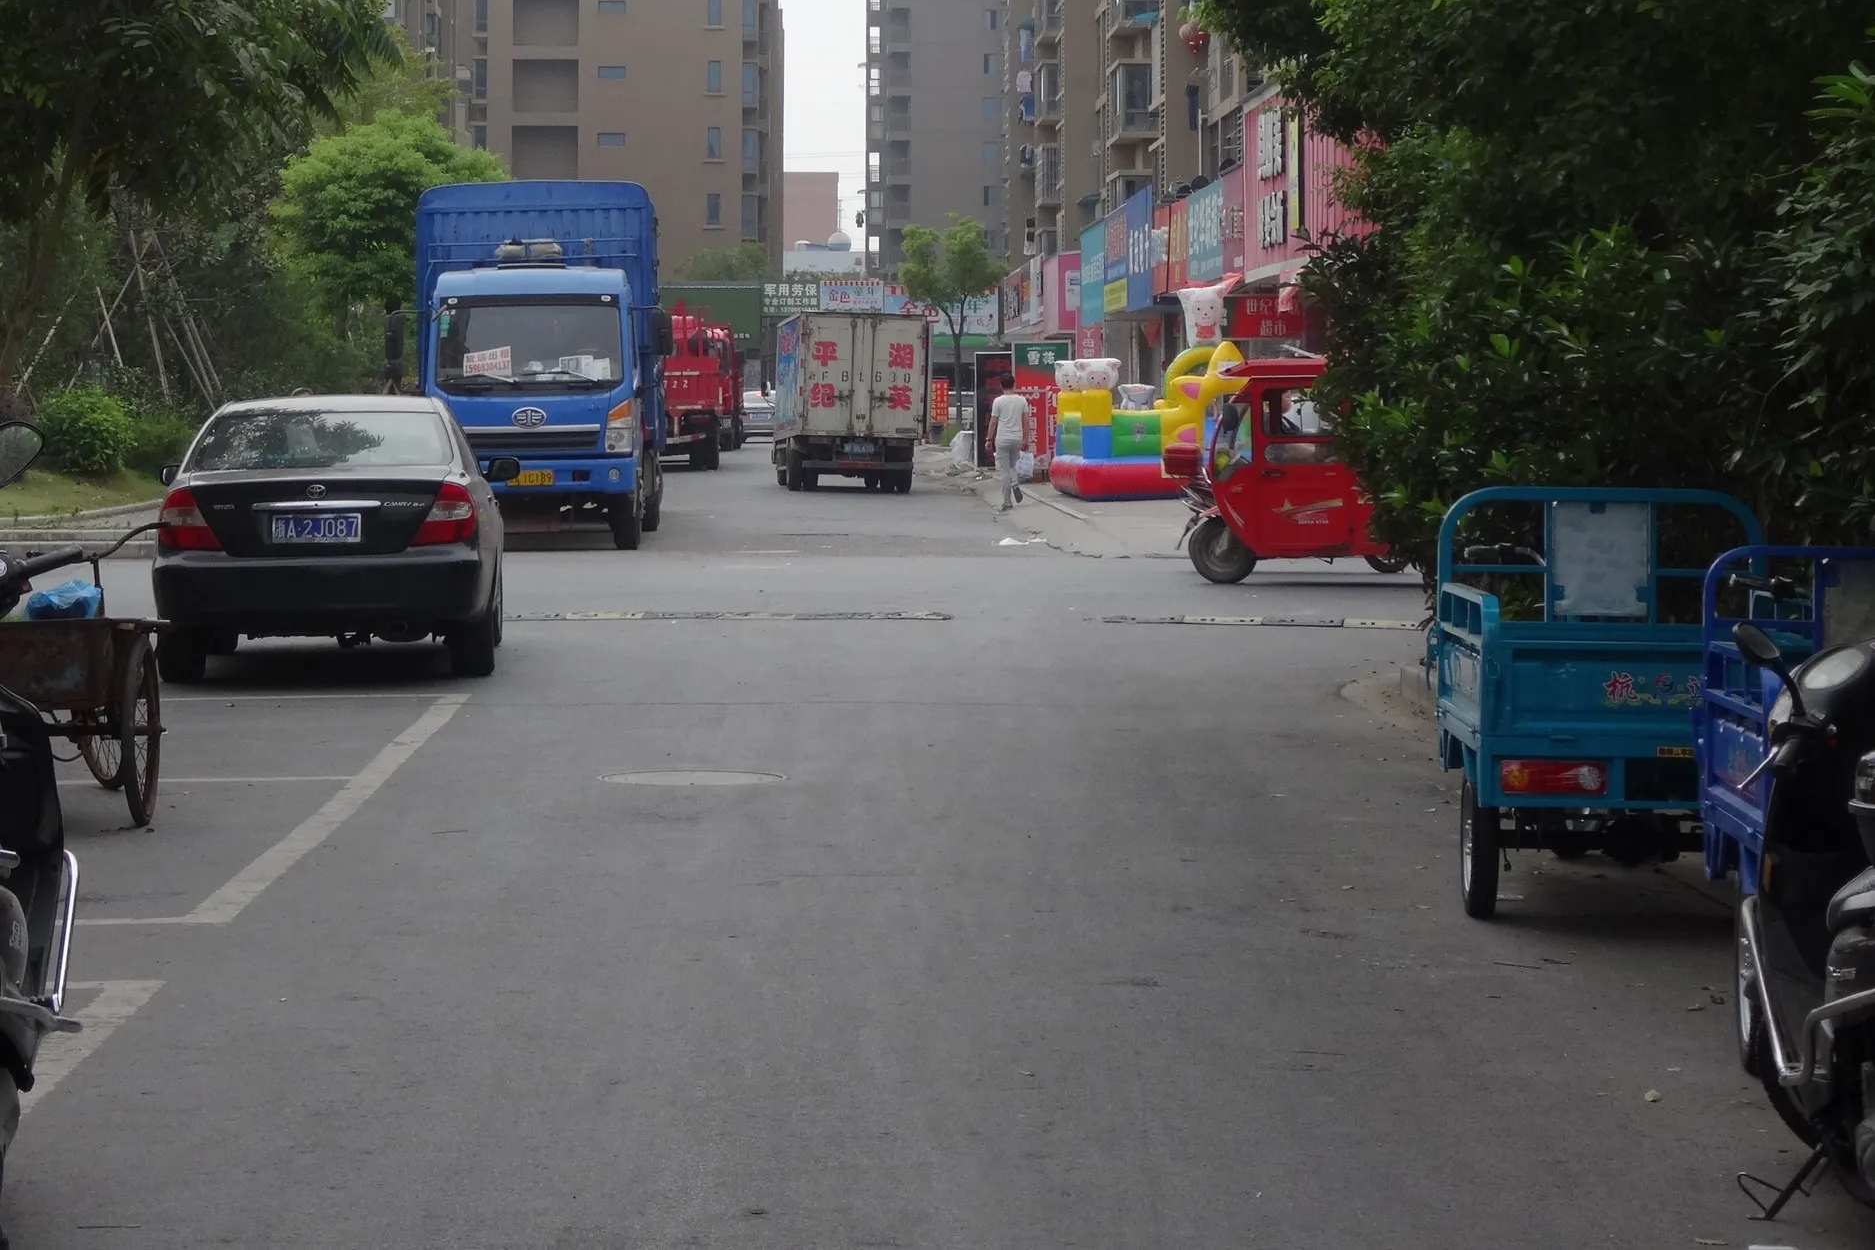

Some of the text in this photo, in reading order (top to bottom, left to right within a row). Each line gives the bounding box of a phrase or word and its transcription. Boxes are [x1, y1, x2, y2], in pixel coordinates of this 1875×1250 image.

[764, 283, 817, 296] 军用劳保
[1260, 319, 1286, 336] 超市
